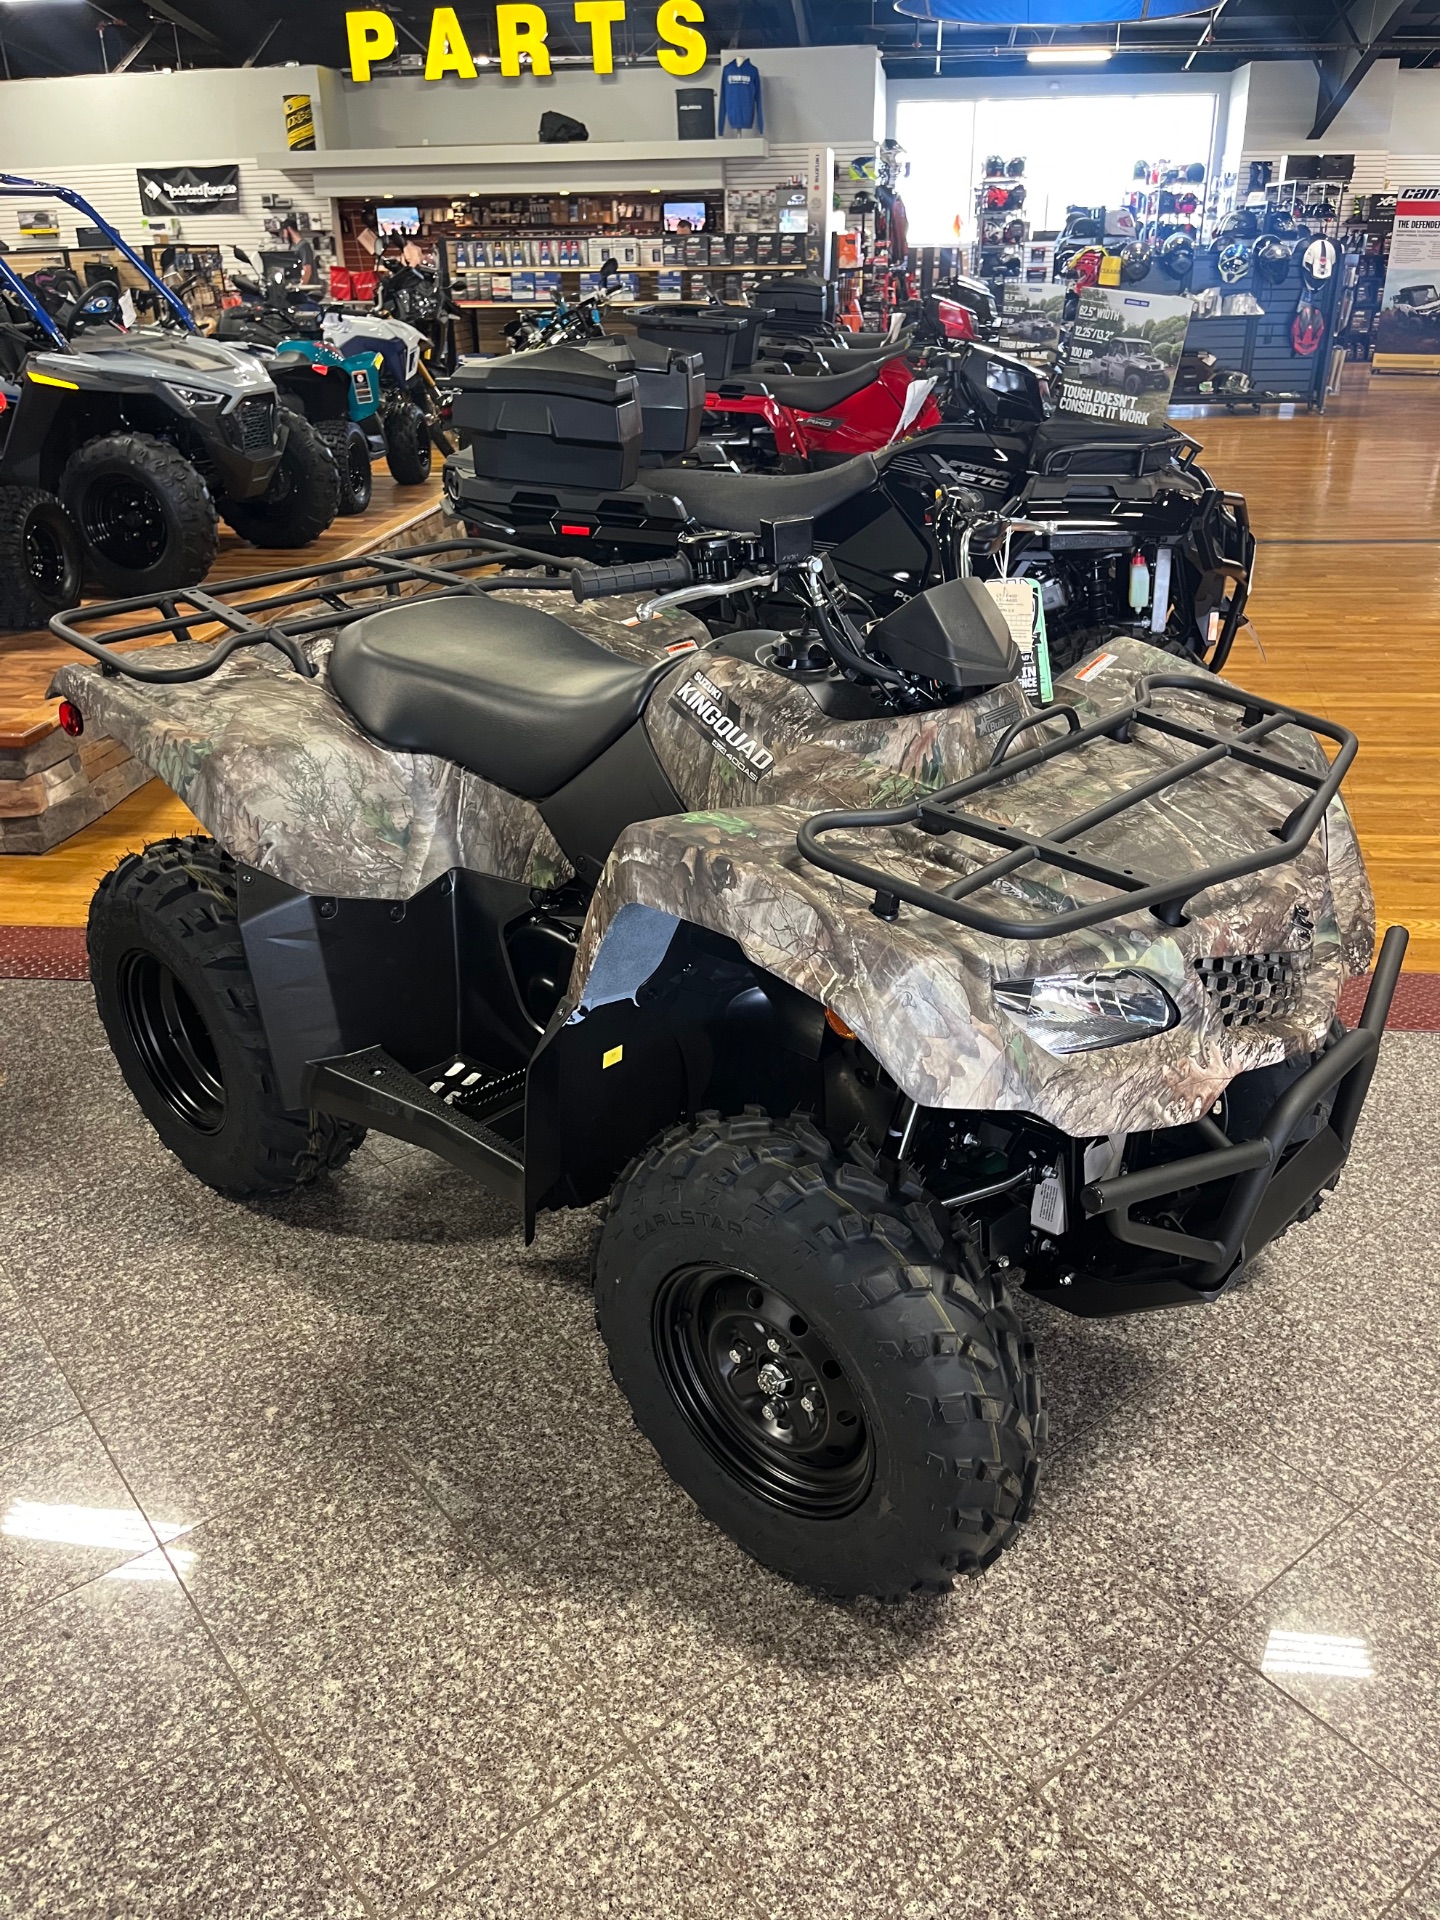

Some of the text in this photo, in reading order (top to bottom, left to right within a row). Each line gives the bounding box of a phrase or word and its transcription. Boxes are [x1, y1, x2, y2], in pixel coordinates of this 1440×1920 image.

[346, 0, 708, 82] PARTS
[1398, 220, 1410, 228] THE
[1097, 307, 1120, 321] WIDTH
[1071, 346, 1094, 359] 100 HP
[1063, 384, 1138, 410] TOUGH DOESN'T
[1059, 397, 1150, 426] CONSIDER IT WORK
[957, 471, 1010, 489] 570
[693, 670, 722, 700] SUZUKI
[676, 681, 775, 770] KINGQUAD
[990, 717, 1005, 731] Built
[632, 1209, 744, 1241] CARLSTAR
